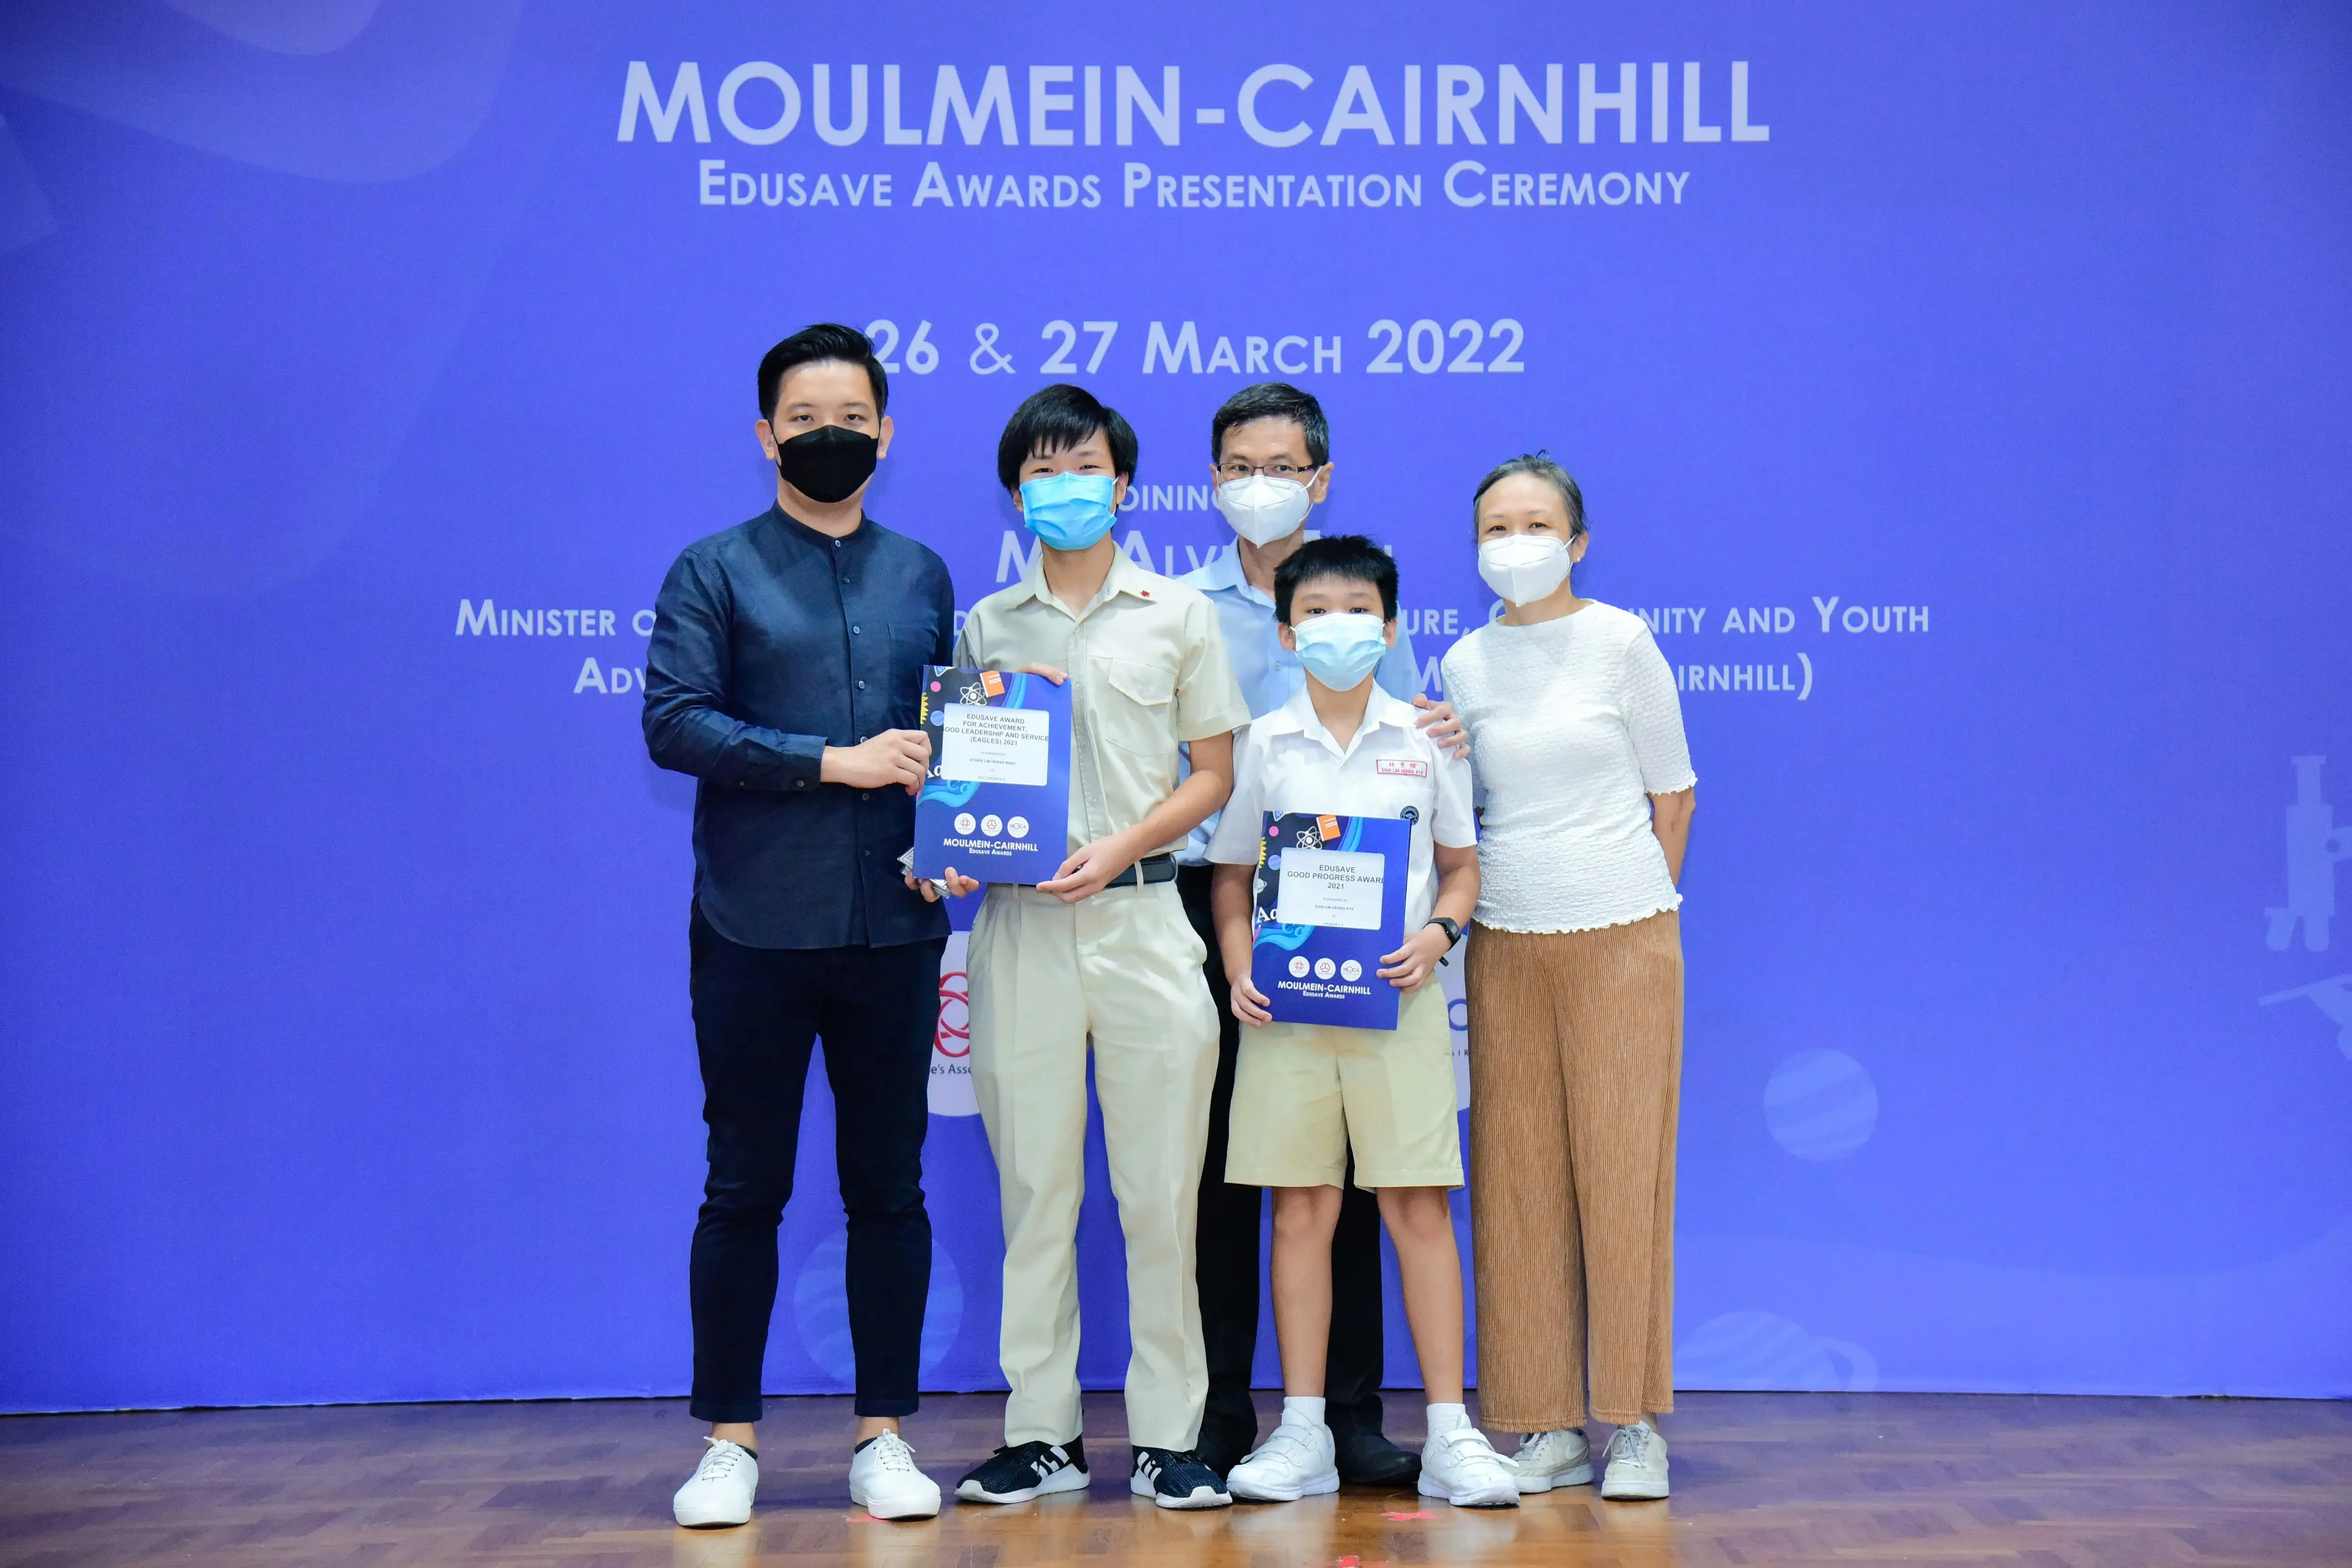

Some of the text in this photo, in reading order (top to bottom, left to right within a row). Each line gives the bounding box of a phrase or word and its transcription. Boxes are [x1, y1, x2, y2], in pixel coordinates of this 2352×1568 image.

[618, 60, 1770, 148] MOULMEIN-CAIRNHILL
[699, 160, 1690, 208] EDUSAVE AWARDS PRESENTATION CEREMONY
[866, 319, 1525, 375] 26 & 27 MARCH 2022
[455, 599, 616, 636] MINISTER
[632, 609, 656, 636] O
[1723, 607, 1795, 634] AND
[1812, 597, 1929, 634] YOUTH
[1678, 653, 1812, 701] IRNHILL)
[962, 728, 1003, 737] LEADERSHIP
[978, 722, 1027, 732] ACHIEVEMENT,
[970, 737, 1001, 746] (EAGLES)
[944, 838, 1038, 852] MOULMEIN-CAIRNHILL
[1319, 865, 1356, 873] EDUSAVE
[1312, 872, 1355, 882] PROGRESS
[1278, 980, 1371, 995] MOULMEIN-CAIRNHILL
